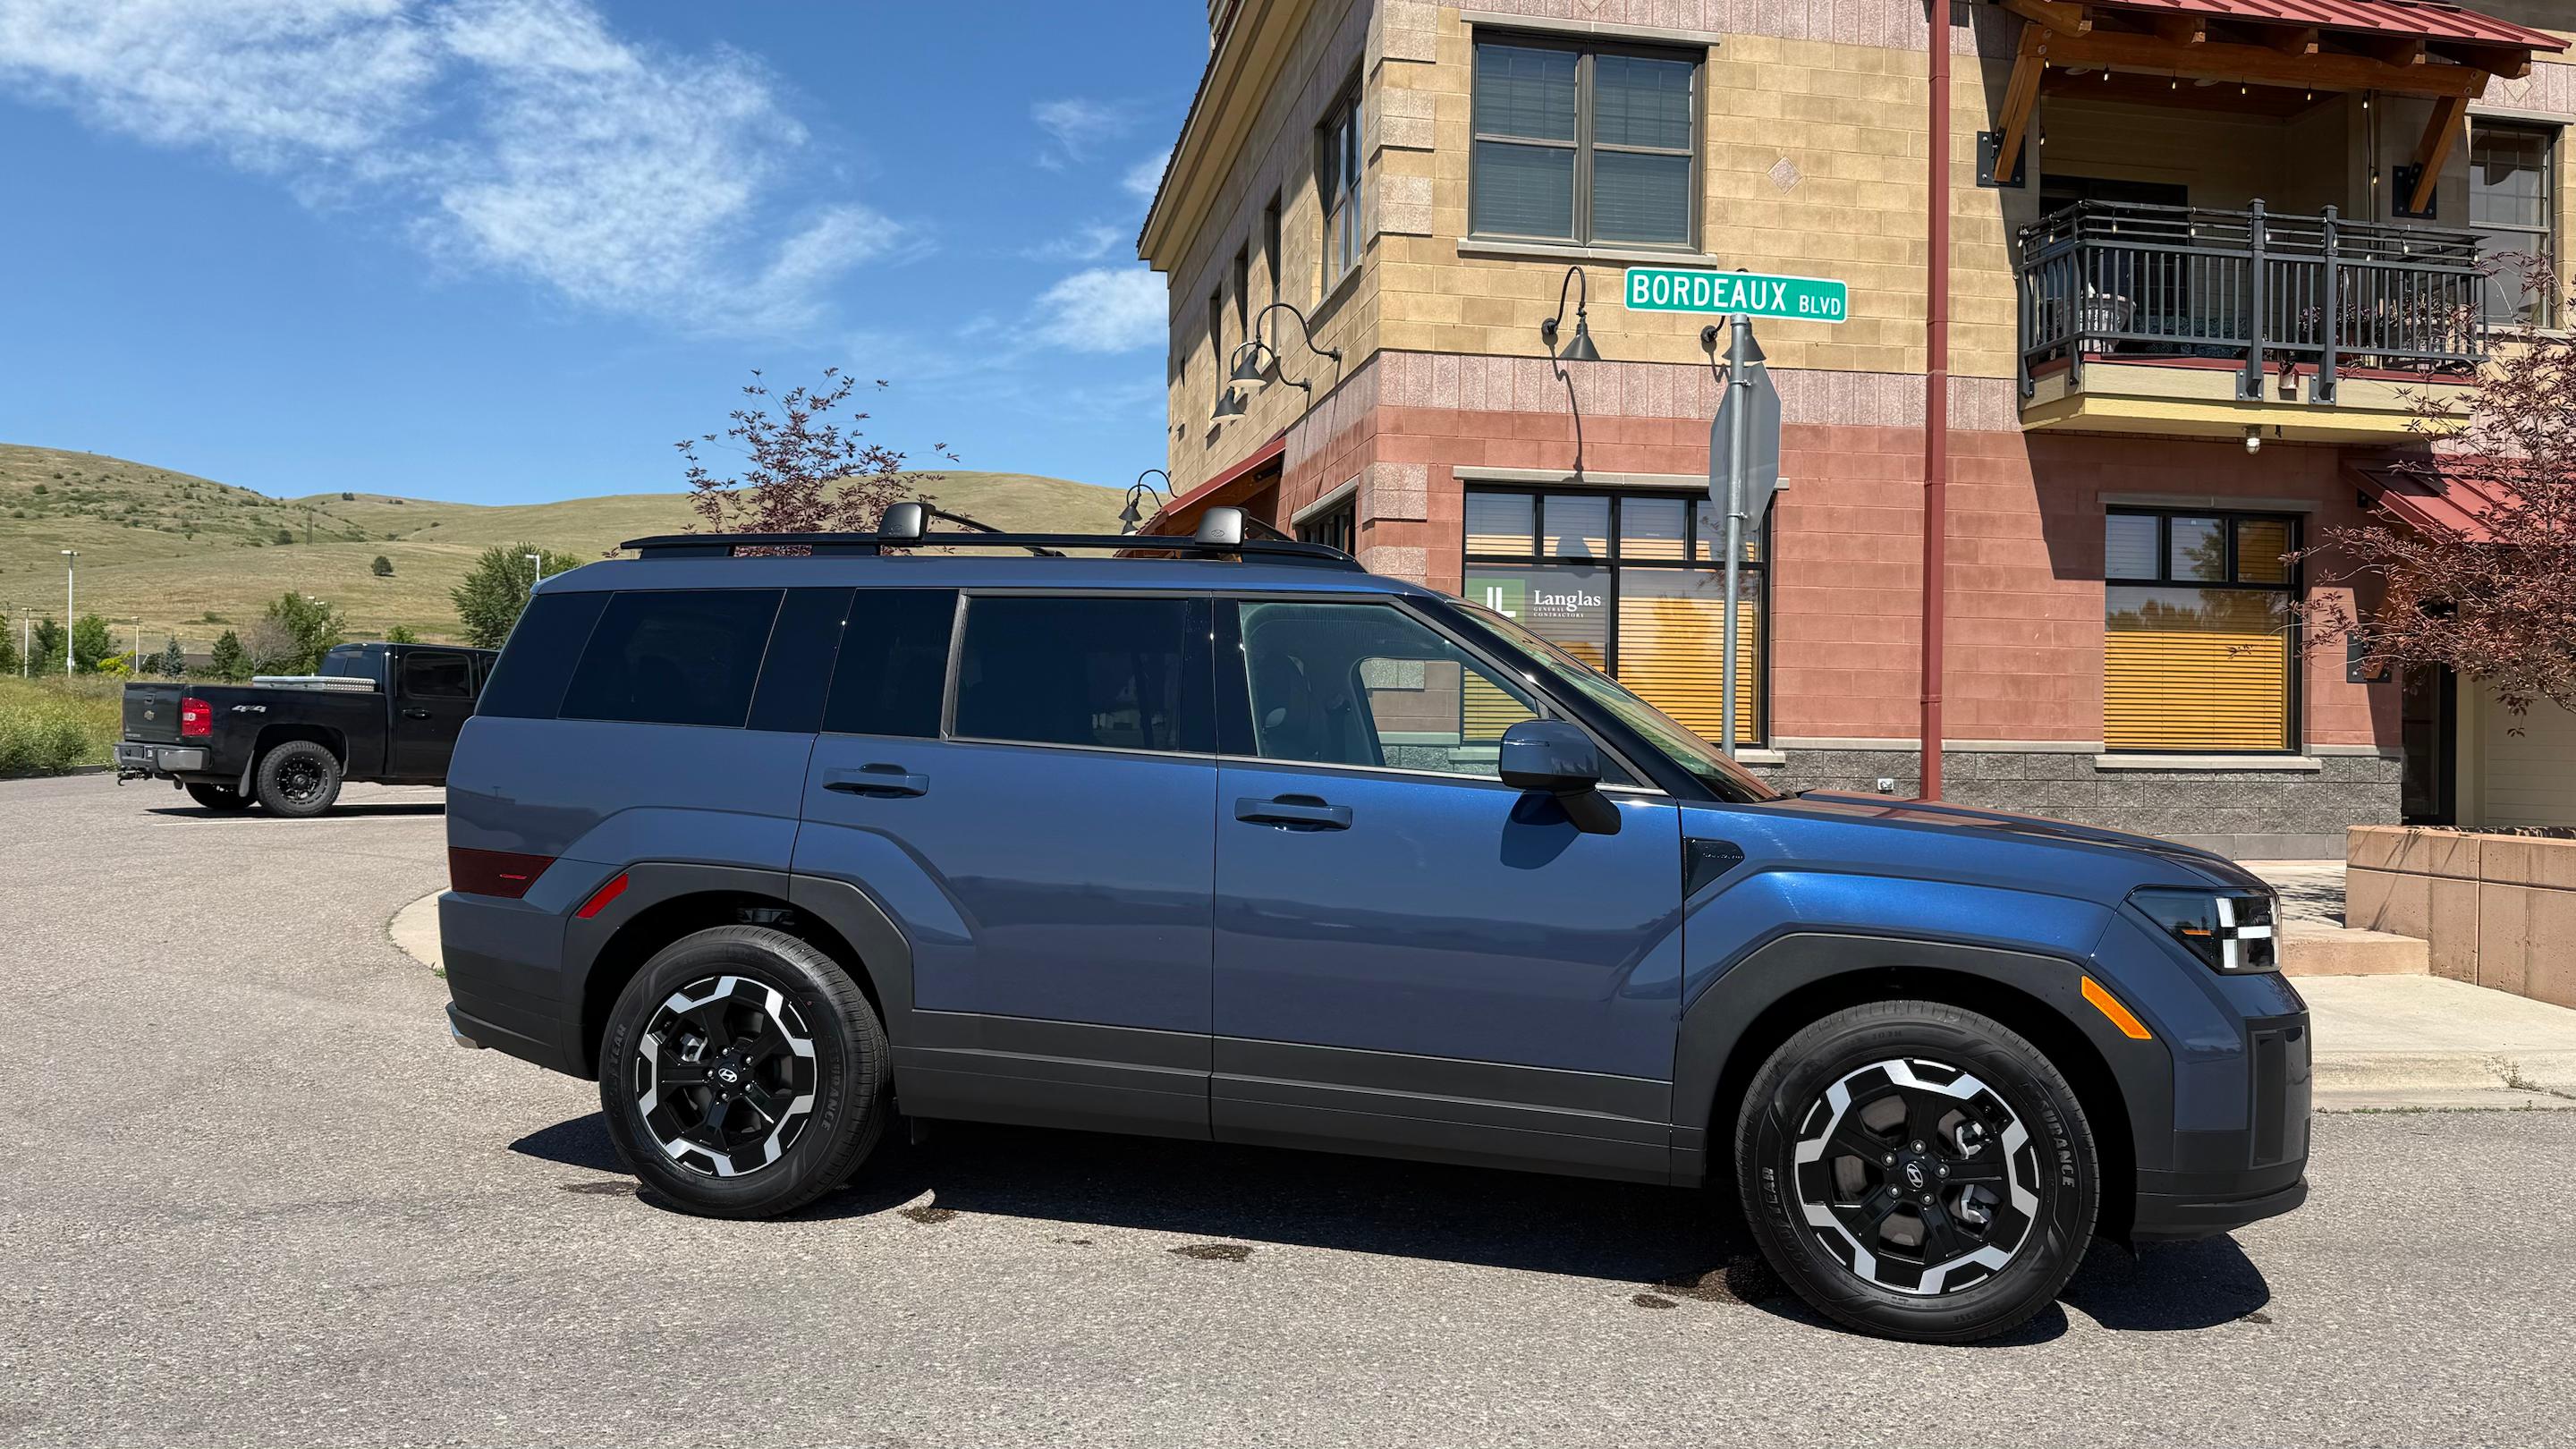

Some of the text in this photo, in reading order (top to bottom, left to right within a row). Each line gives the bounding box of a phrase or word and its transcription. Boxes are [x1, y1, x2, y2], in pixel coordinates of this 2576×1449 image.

[1632, 275, 1842, 316] BORDEAUX BLVD
[1534, 589, 1601, 612] Langlas
